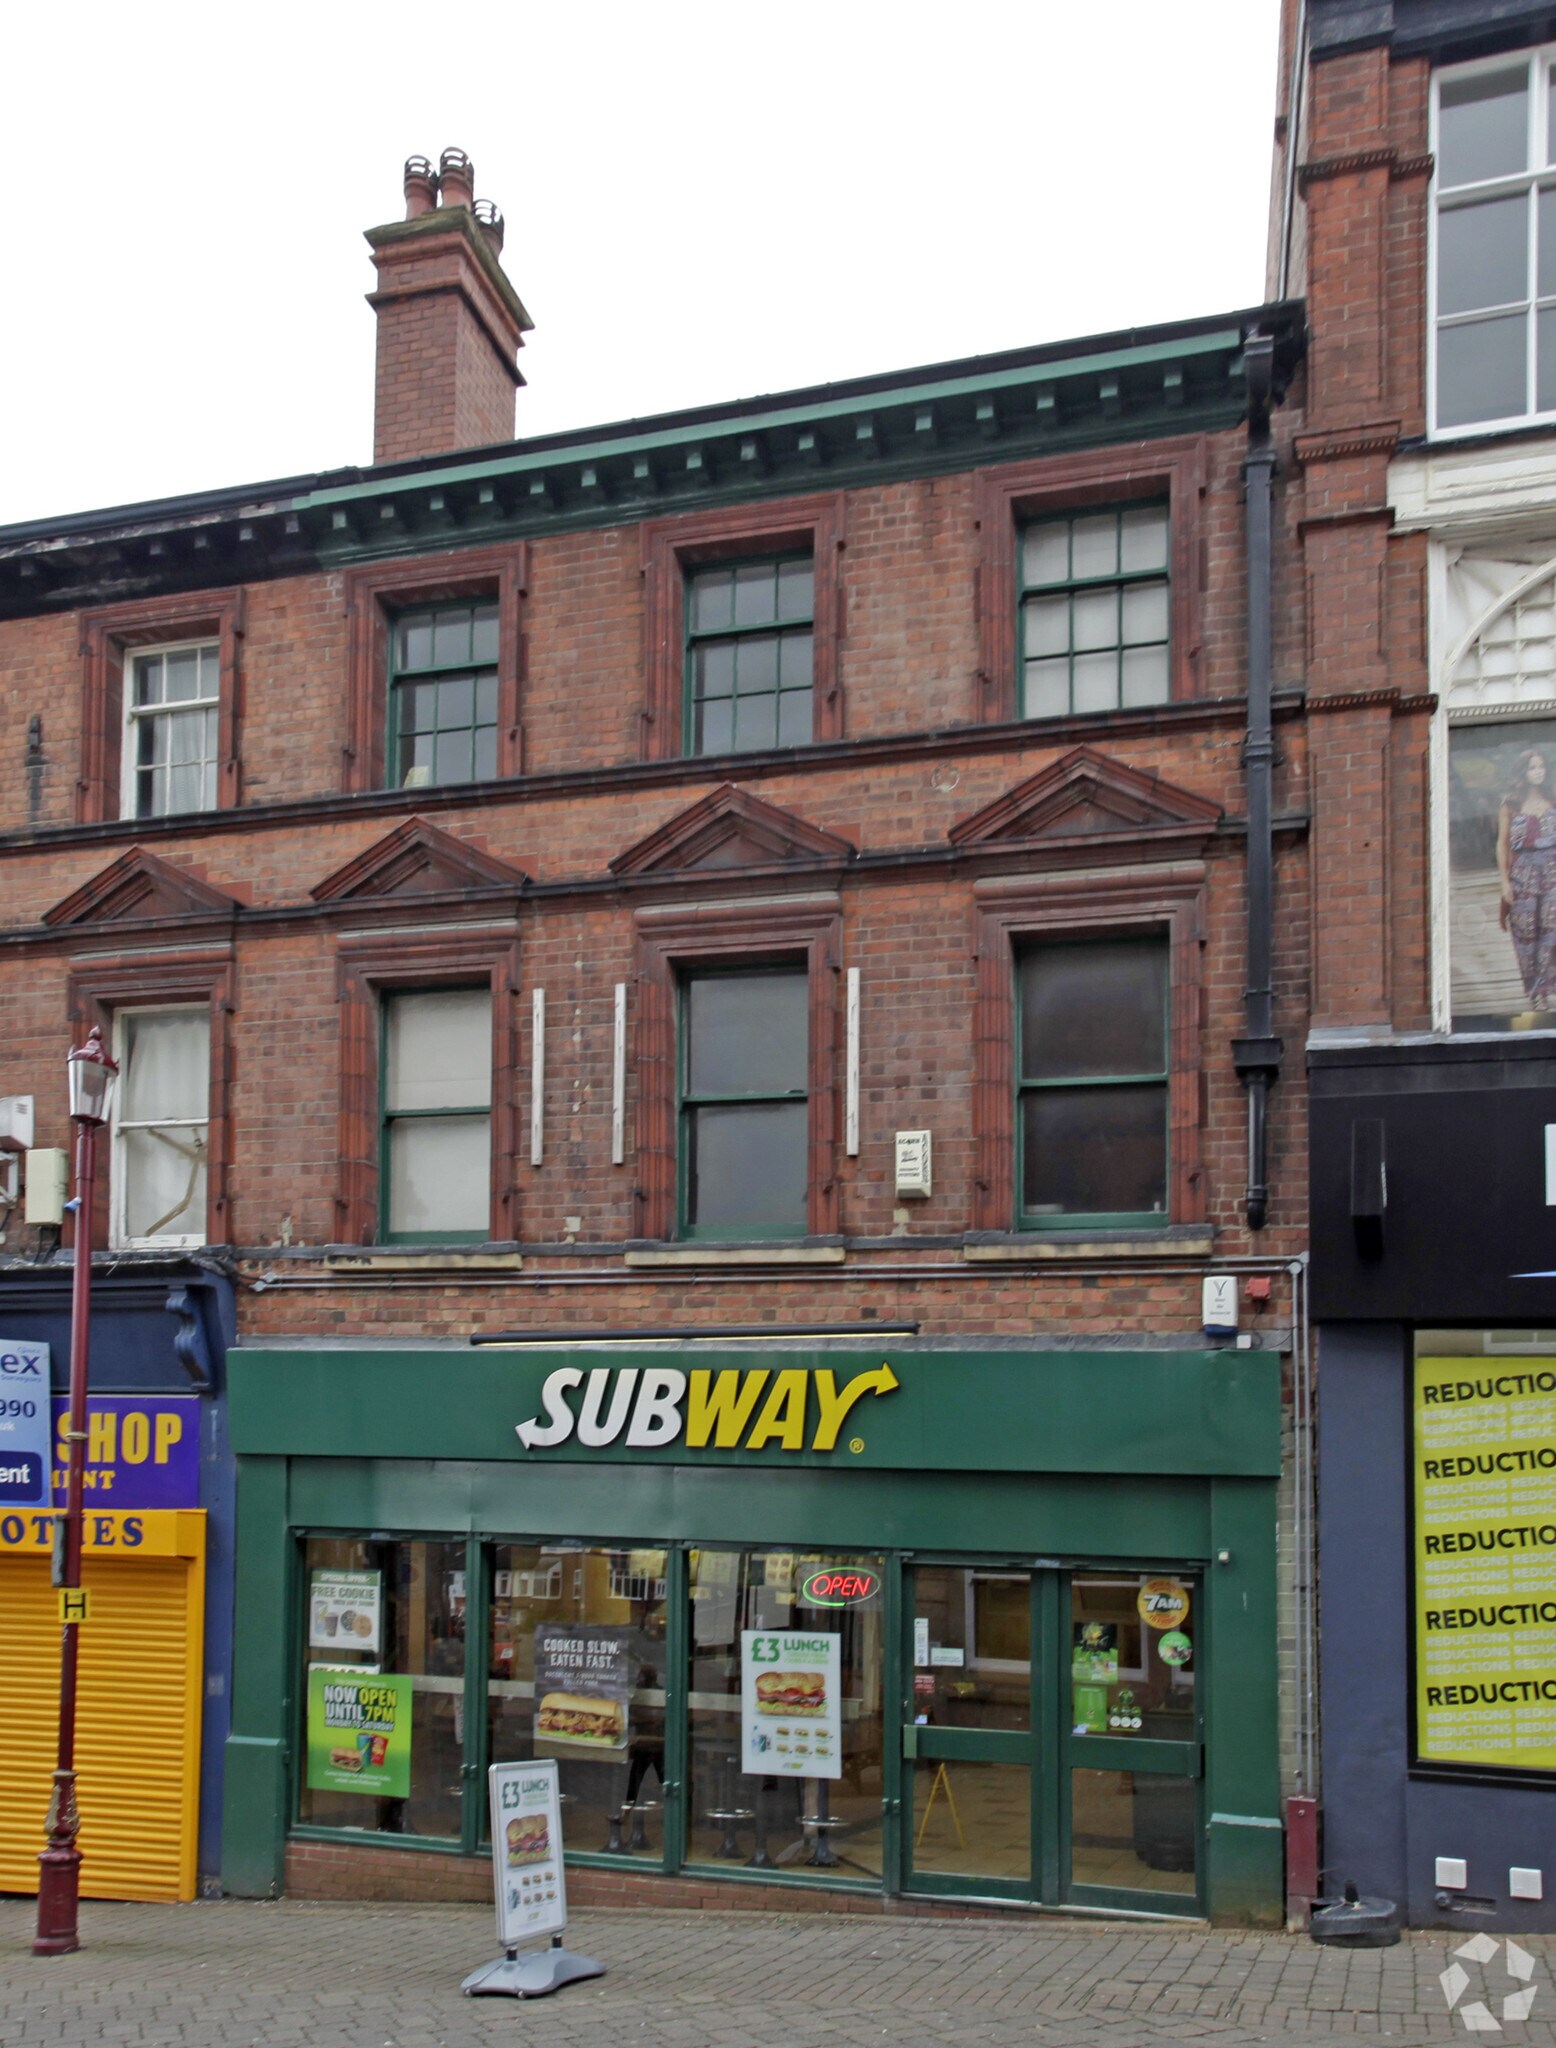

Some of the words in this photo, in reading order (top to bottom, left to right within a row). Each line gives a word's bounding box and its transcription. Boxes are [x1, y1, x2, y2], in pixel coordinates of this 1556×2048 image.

[1, 1353, 41, 1375] ex
[1423, 1372, 1556, 1404] REDUCTIO
[515, 1362, 899, 1451] SUBWAY
[1424, 1448, 1556, 1479] REDUCTIO
[1, 1515, 143, 1546] OTES
[1425, 1525, 1556, 1554] REDUCTIO
[311, 1585, 337, 1598] FREE
[339, 1587, 375, 1600] COOKIE
[812, 1575, 872, 1596] OPEN
[64, 1592, 85, 1619] H
[1144, 1594, 1183, 1612] 7AM
[1426, 1602, 1556, 1630] REDUCTIO
[544, 1639, 583, 1653] COOKED
[752, 1637, 781, 1663] £3
[784, 1638, 830, 1652] LUNCH
[550, 1653, 583, 1668] EATEN
[324, 1685, 358, 1702] NOW
[359, 1688, 397, 1707] OPEN
[1427, 1680, 1556, 1706] REDUCTIO
[326, 1702, 365, 1719] UNTIL
[365, 1706, 395, 1722] 7PM
[502, 1781, 520, 1809] £3
[522, 1778, 550, 1793] LUNCH
